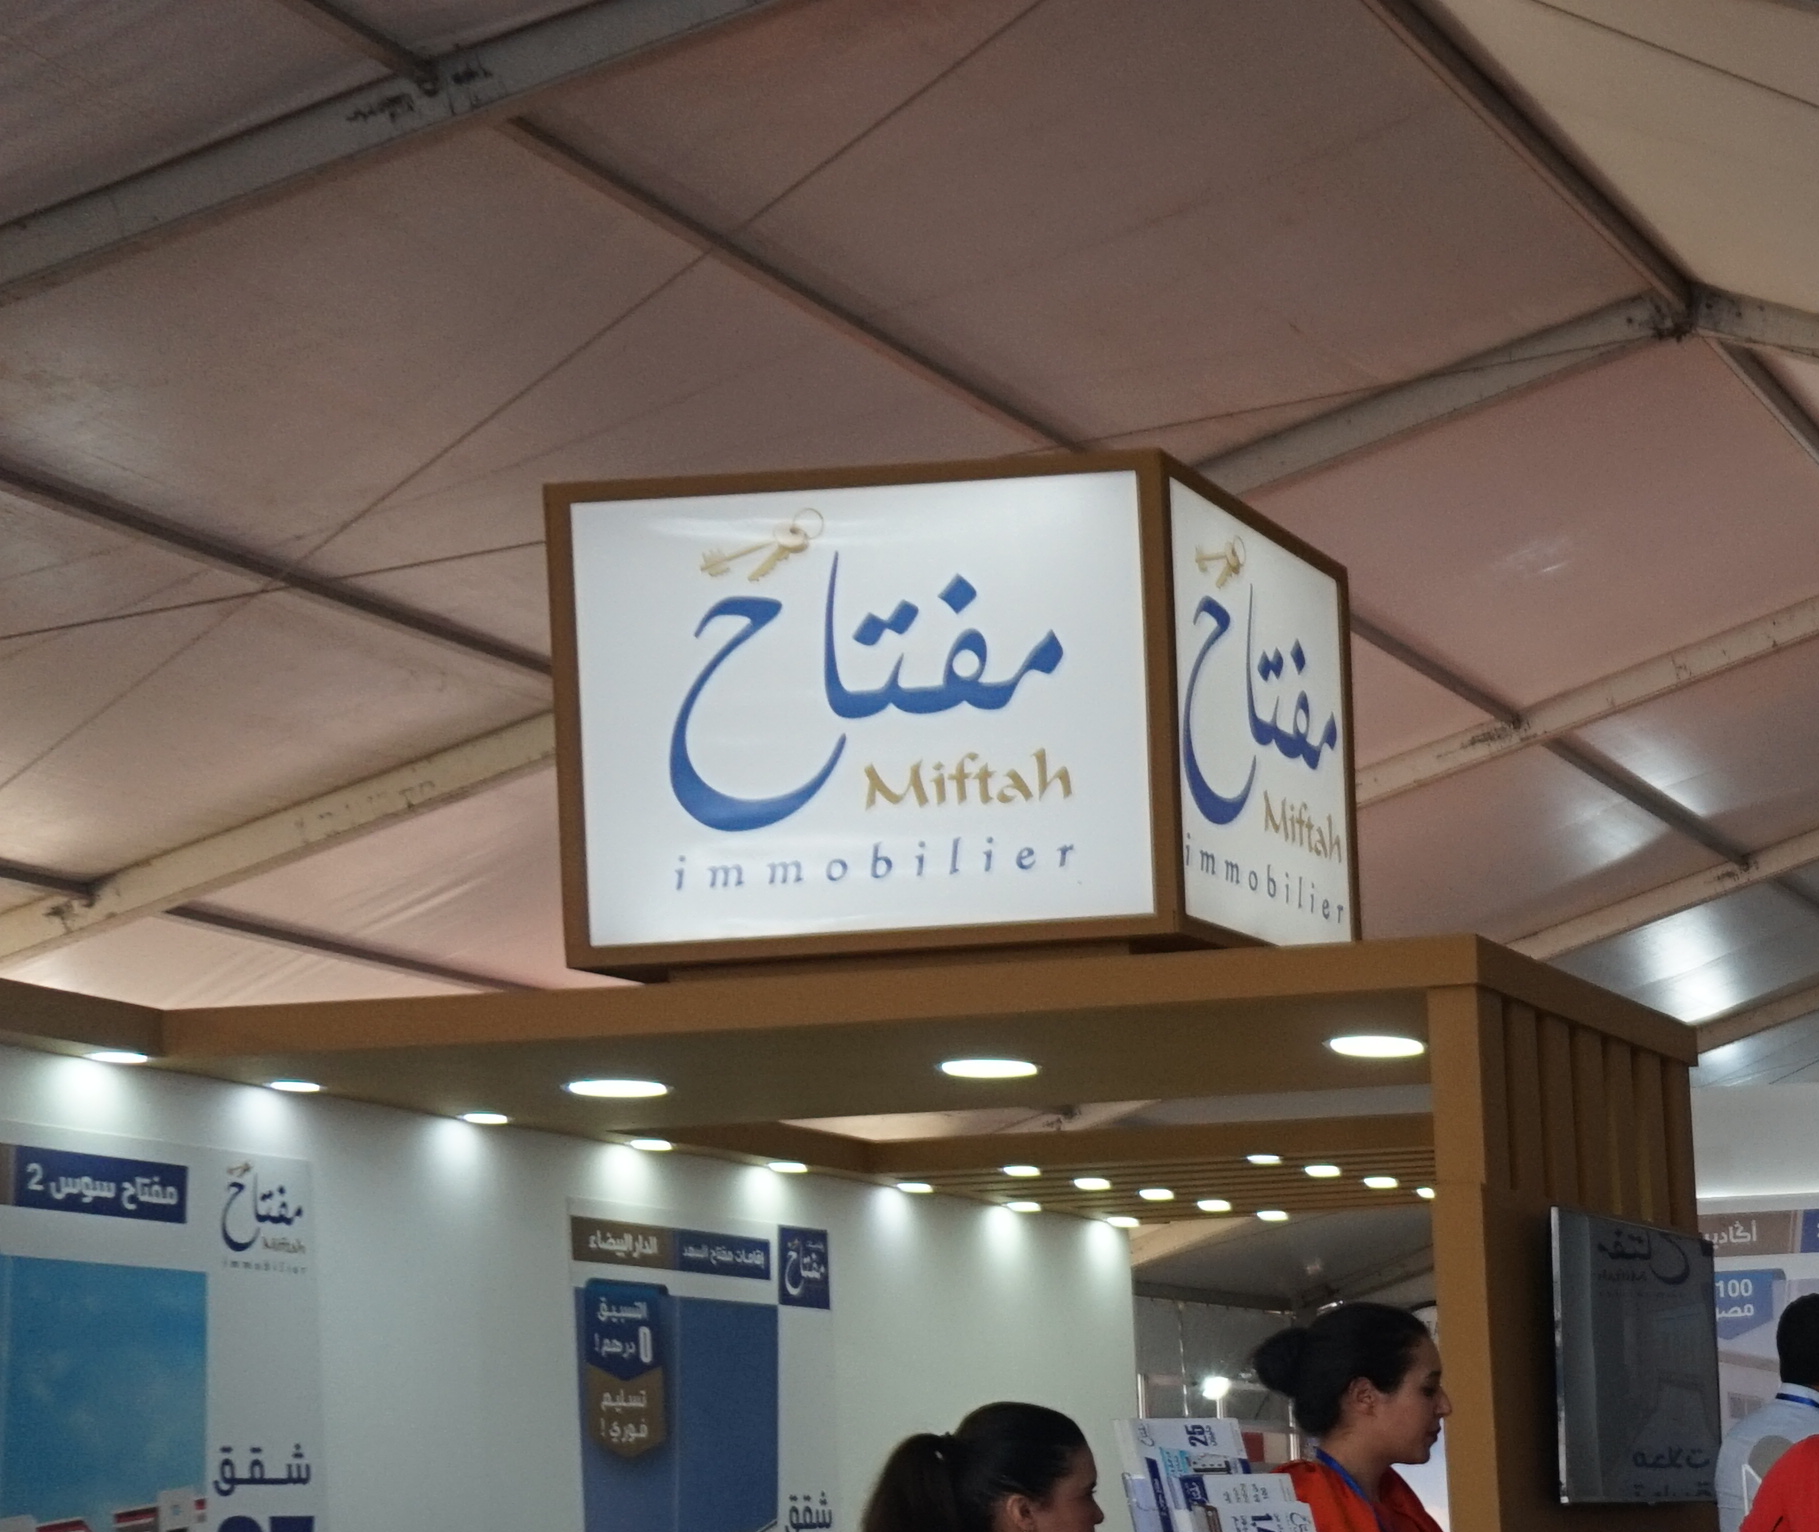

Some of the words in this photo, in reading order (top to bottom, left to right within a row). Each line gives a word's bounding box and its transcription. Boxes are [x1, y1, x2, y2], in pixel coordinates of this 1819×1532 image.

[669, 550, 1064, 831] مفتاح
[1183, 583, 1338, 825] مفتاح
[864, 747, 1075, 811] Miftah
[1264, 791, 1342, 863] Miftah
[674, 837, 1075, 891] immobilier
[1183, 833, 1345, 925] immobilier
[26, 1162, 44, 1191] 2
[50, 1174, 116, 1203] سوس
[121, 1175, 178, 1211] مفتاح
[213, 1443, 312, 1497] شقق
